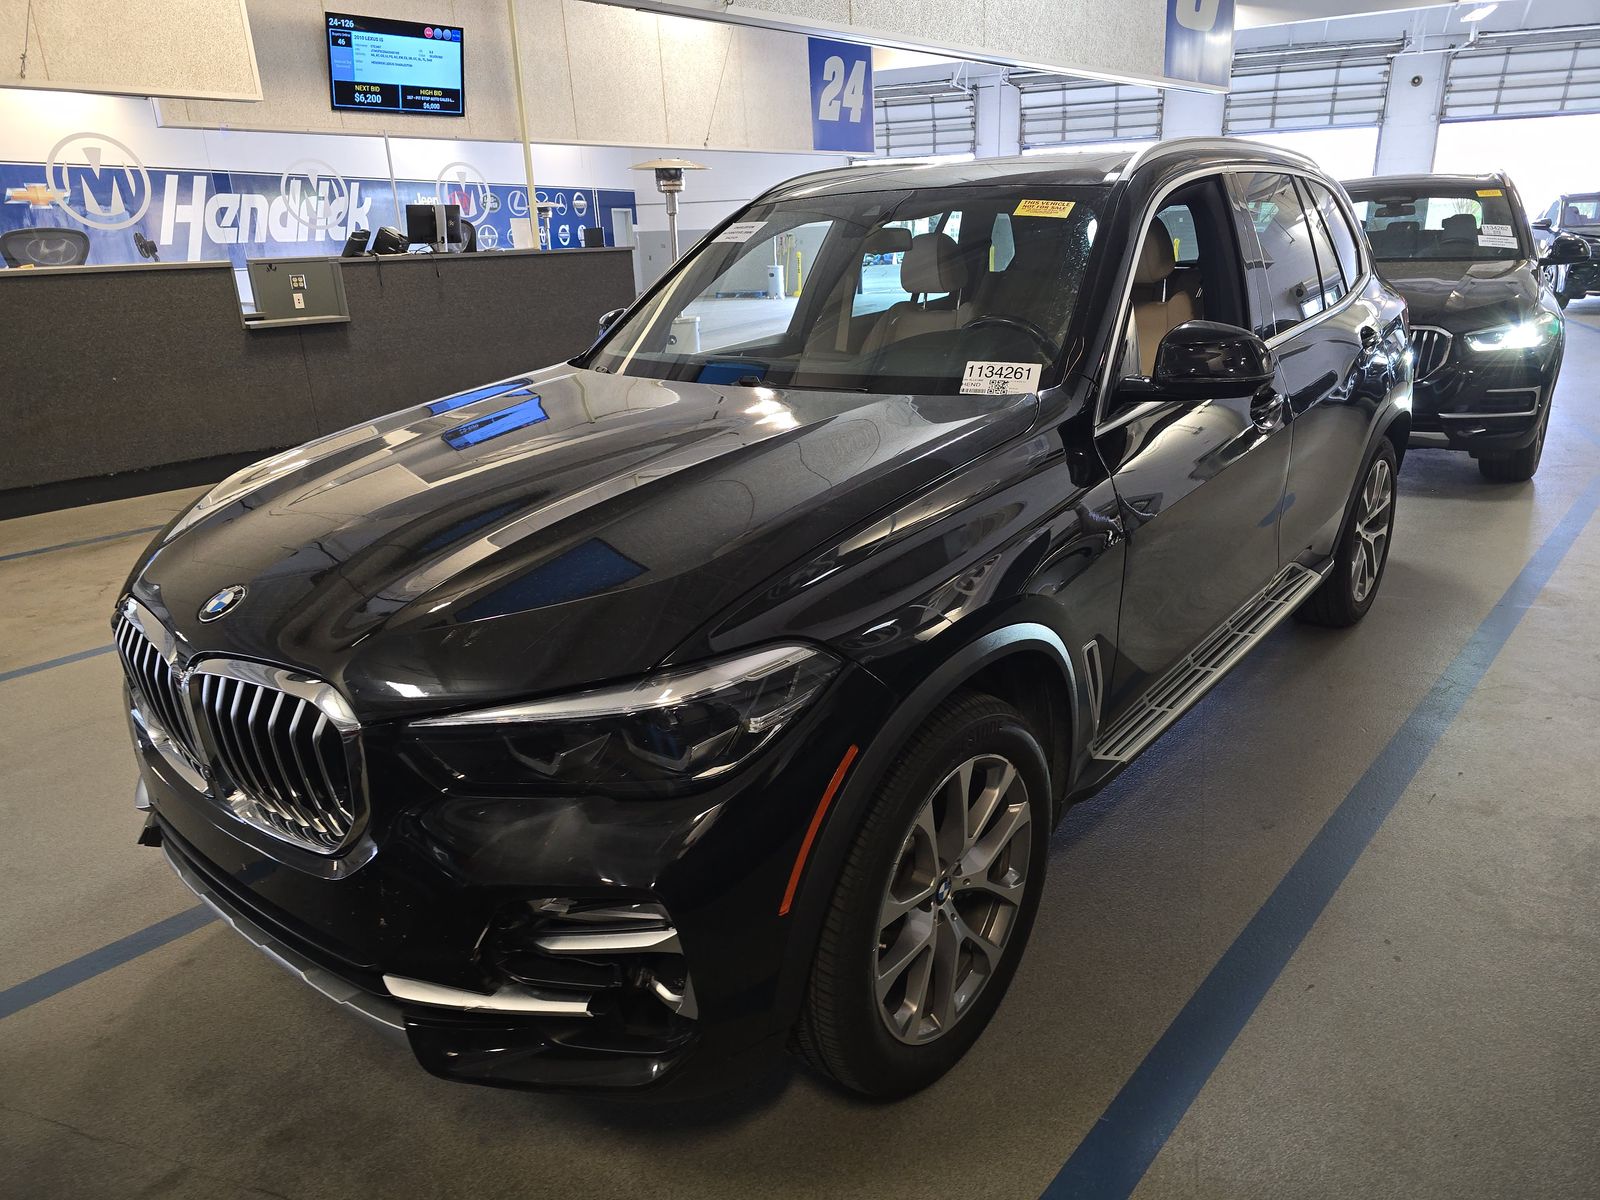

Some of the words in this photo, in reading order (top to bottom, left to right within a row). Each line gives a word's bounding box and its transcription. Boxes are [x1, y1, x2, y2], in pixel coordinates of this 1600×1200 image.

[328, 17, 355, 29] 24-126
[337, 38, 346, 46] 46
[818, 55, 867, 123] 24
[354, 93, 382, 104] $6,200
[423, 102, 441, 110] $6,000
[160, 174, 372, 262] Hendrick
[968, 365, 1032, 380] 1134261
